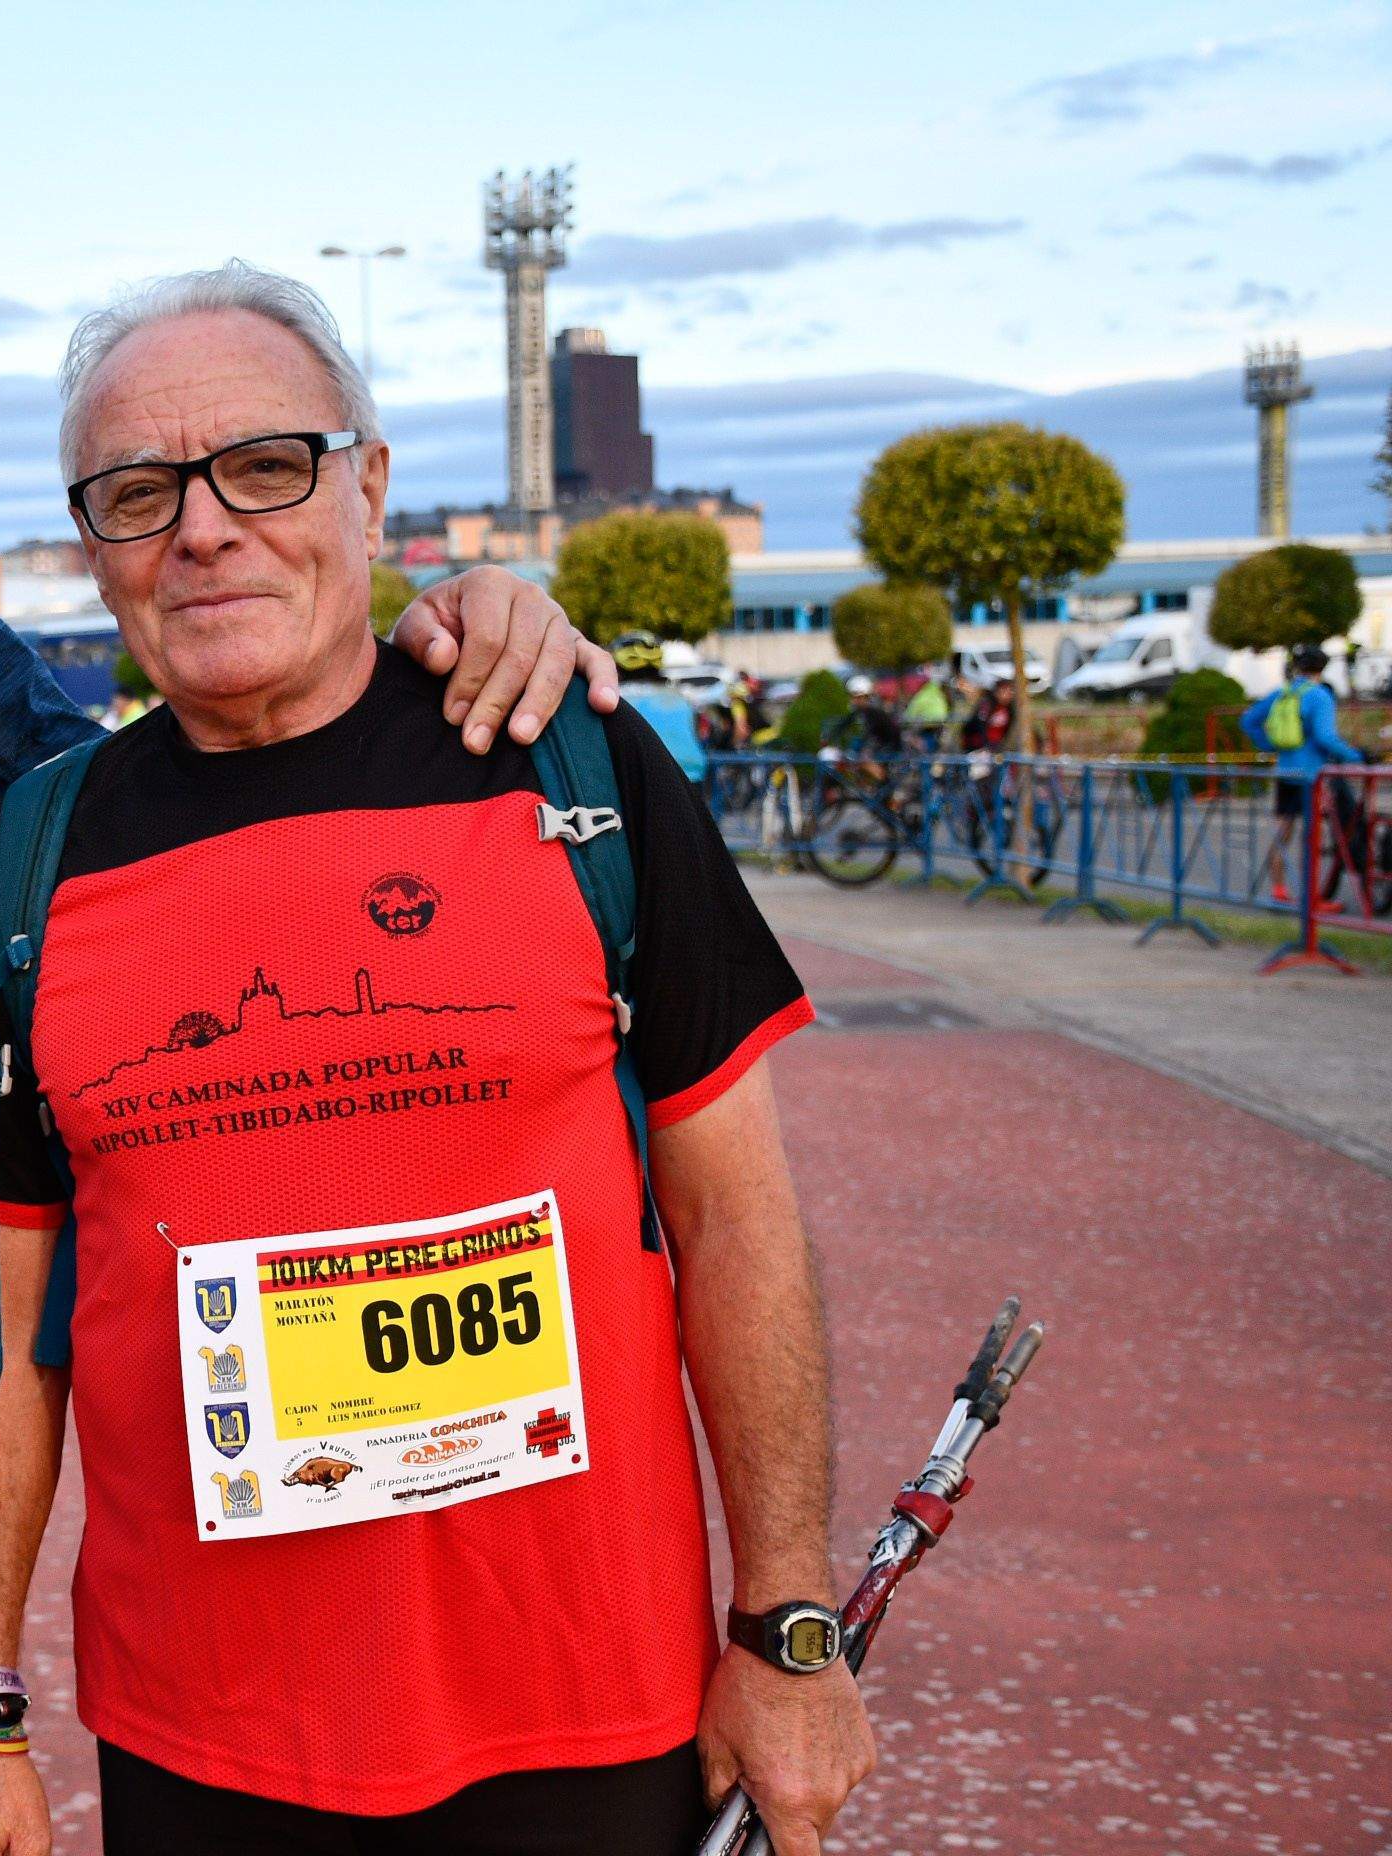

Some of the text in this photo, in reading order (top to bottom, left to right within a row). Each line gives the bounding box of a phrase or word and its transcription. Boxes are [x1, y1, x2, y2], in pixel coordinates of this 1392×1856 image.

[102, 1046, 469, 1121] XIV CAMINADA POPULAR
[92, 1078, 513, 1156] RIPOLLET-TIBIDABO-RIPOLLET
[269, 1216, 542, 1288] 101KM PEREGRINOS
[274, 1270, 542, 1375] MARATÓN 6085
[276, 1311, 337, 1328] MONTAÑA
[285, 1397, 375, 1415] CAJON NOMBRE
[296, 1402, 422, 1427] 5 LUIS MARCO GOMEZ
[366, 1410, 508, 1448] PANADERIA CONCHITA
[388, 1475, 419, 1488] poder
[422, 1472, 435, 1481] de
[437, 1469, 447, 1479] la
[449, 1463, 475, 1475] masa
